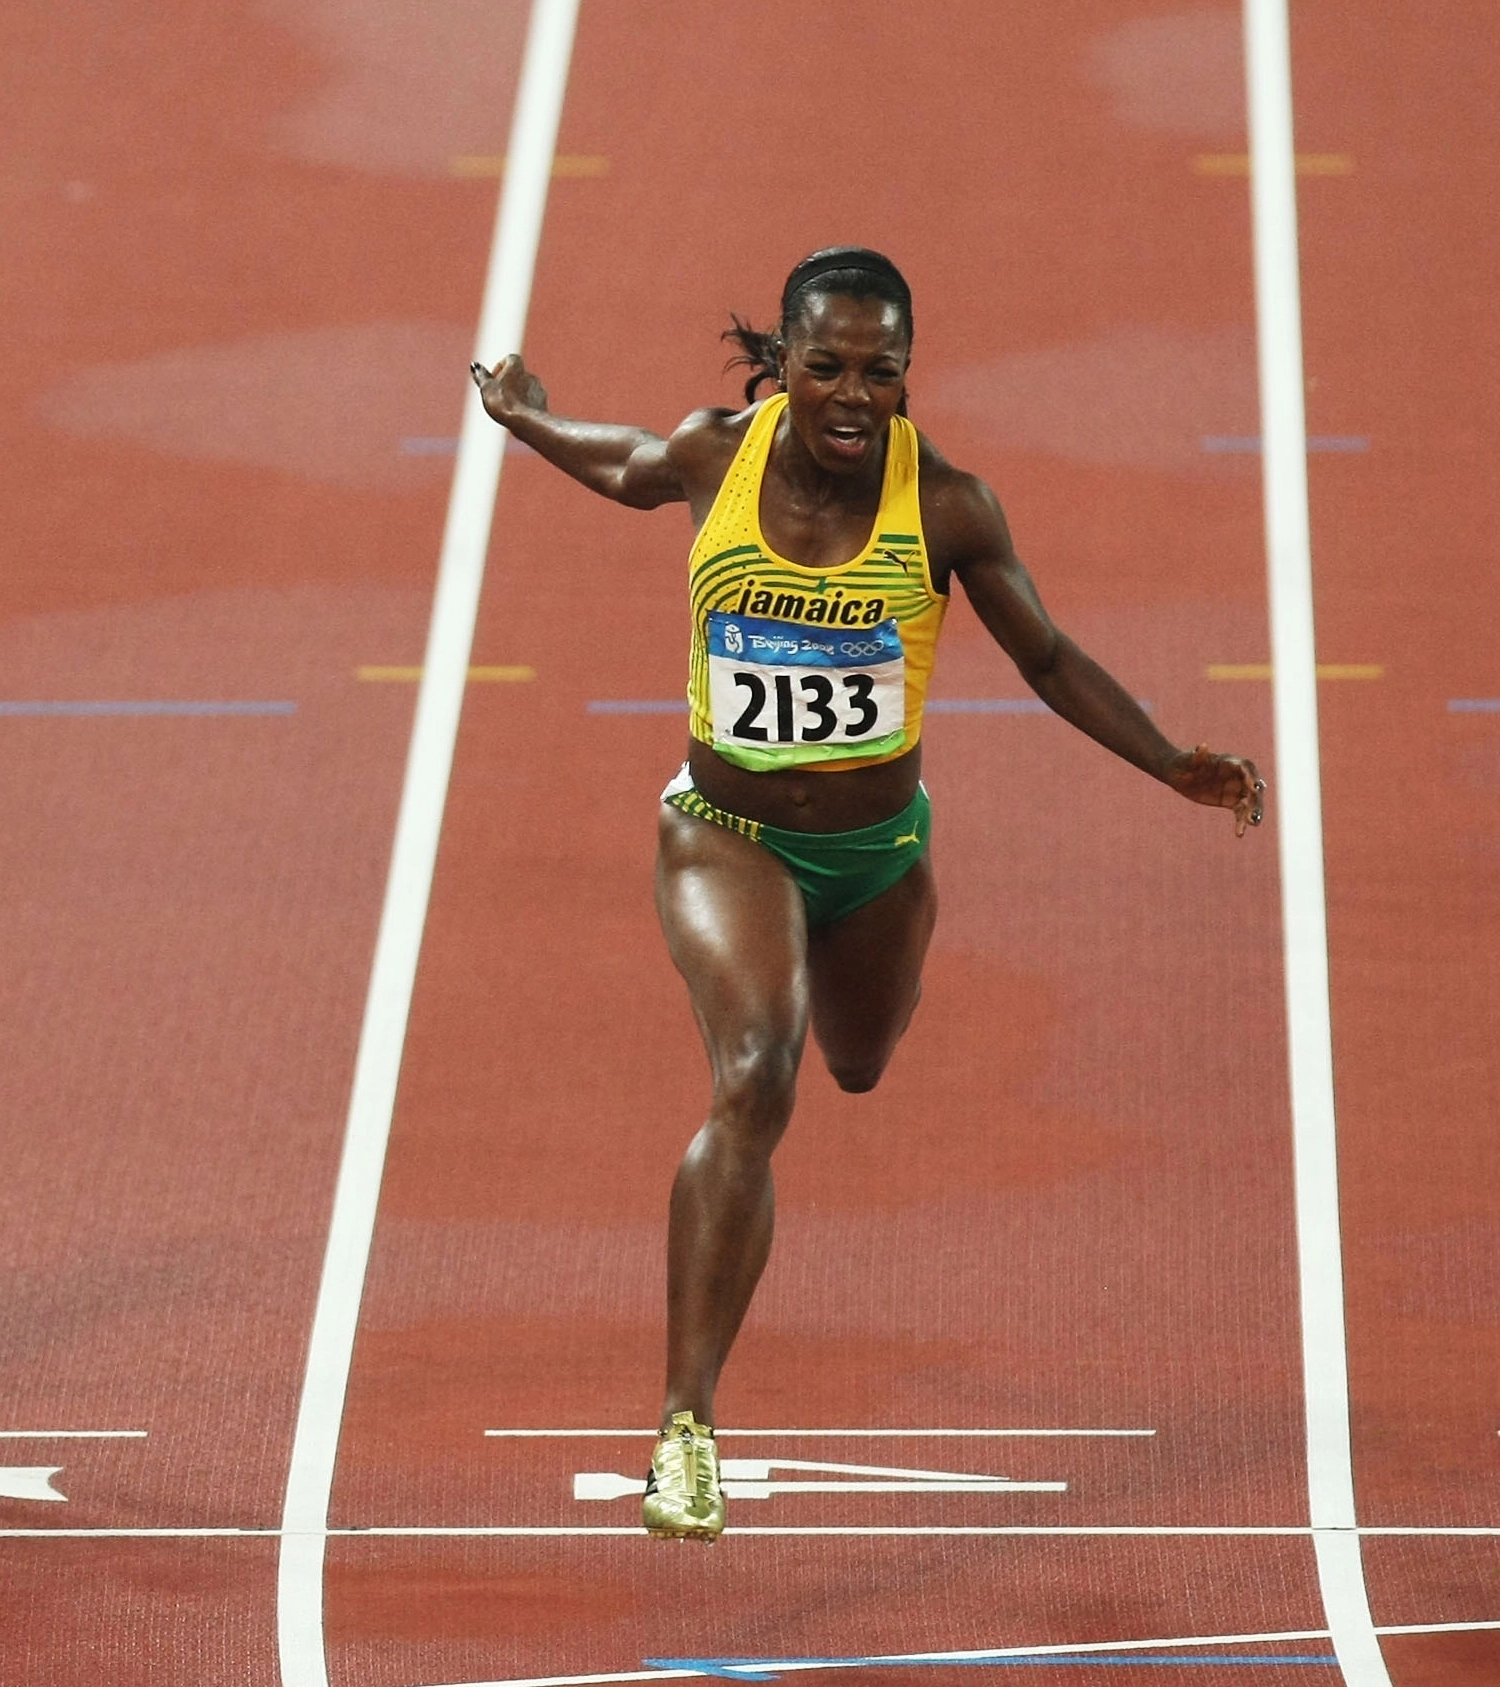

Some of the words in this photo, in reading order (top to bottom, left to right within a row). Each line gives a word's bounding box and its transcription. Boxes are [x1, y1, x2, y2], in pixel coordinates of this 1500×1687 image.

[728, 579, 885, 625] jamaica
[747, 635, 799, 655] Beijing
[800, 639, 835, 656] 2008
[732, 672, 879, 742] 2133
[572, 1457, 1068, 1502] 4
